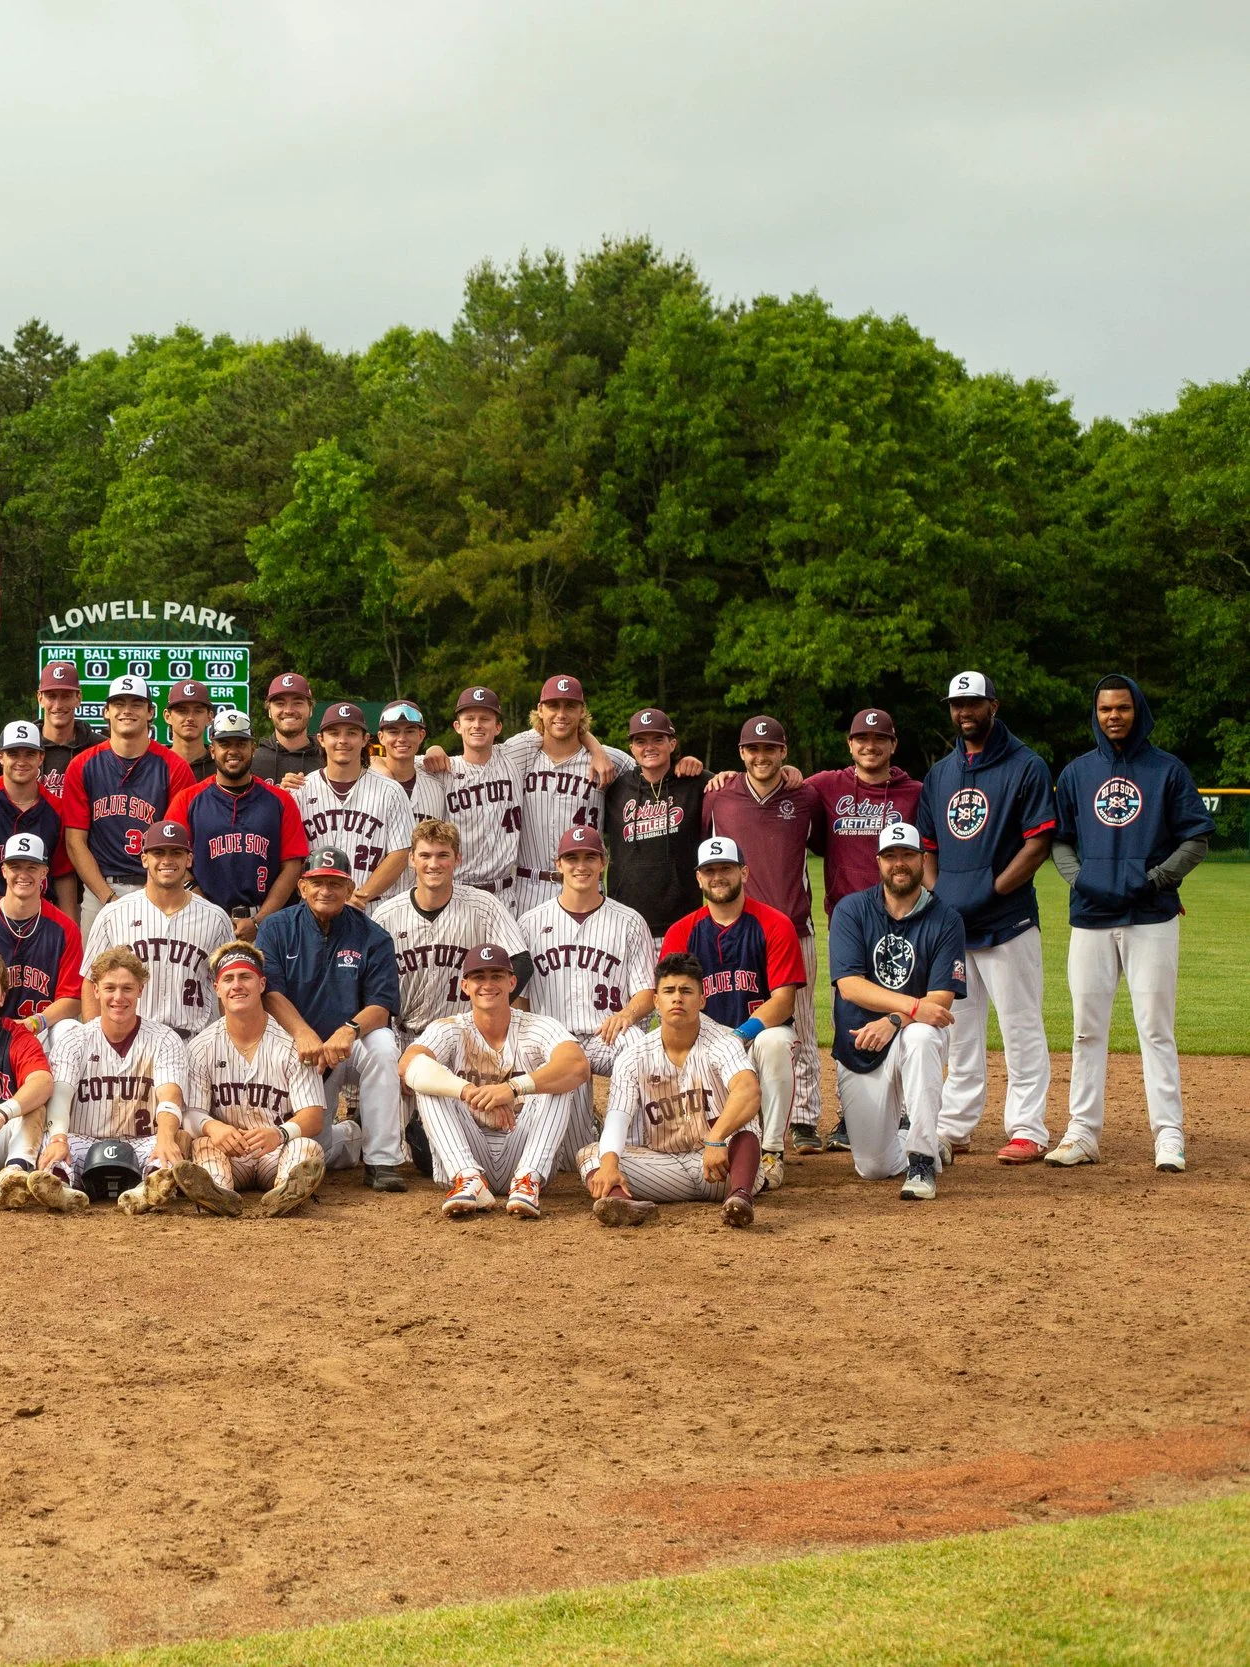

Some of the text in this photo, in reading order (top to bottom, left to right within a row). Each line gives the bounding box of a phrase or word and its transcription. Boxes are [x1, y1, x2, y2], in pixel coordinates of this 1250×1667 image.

[48, 600, 236, 635] LOWELL PARK
[48, 649, 243, 661] MPH BALL STRIKE OUT INNING
[92, 663, 230, 677] 0 0 0 10
[957, 676, 970, 690] S
[121, 678, 134, 691] S
[211, 687, 234, 697] ERR
[75, 706, 103, 716] UEST
[16, 726, 29, 739] S
[523, 770, 597, 800] OTUIT
[1119, 783, 1135, 799] SOX
[93, 794, 156, 824] BLUE SOX
[501, 805, 522, 834] 40
[572, 806, 599, 830] 43
[302, 809, 384, 842] COTUIT
[891, 827, 905, 840] S
[18, 838, 31, 852] S
[209, 833, 270, 861] BLUE SOX
[353, 844, 384, 872] 27
[710, 841, 723, 855] S
[321, 851, 335, 867] S
[256, 866, 268, 893] 2
[127, 938, 209, 973] OTUIT
[395, 944, 470, 975] COTUIT
[533, 944, 621, 979] COTUIT
[23, 965, 50, 997] SOX
[701, 969, 759, 999] BLUE SOX
[593, 983, 623, 1012] 39
[77, 1076, 154, 1103] COTUIT
[211, 1082, 289, 1112] COTUIT
